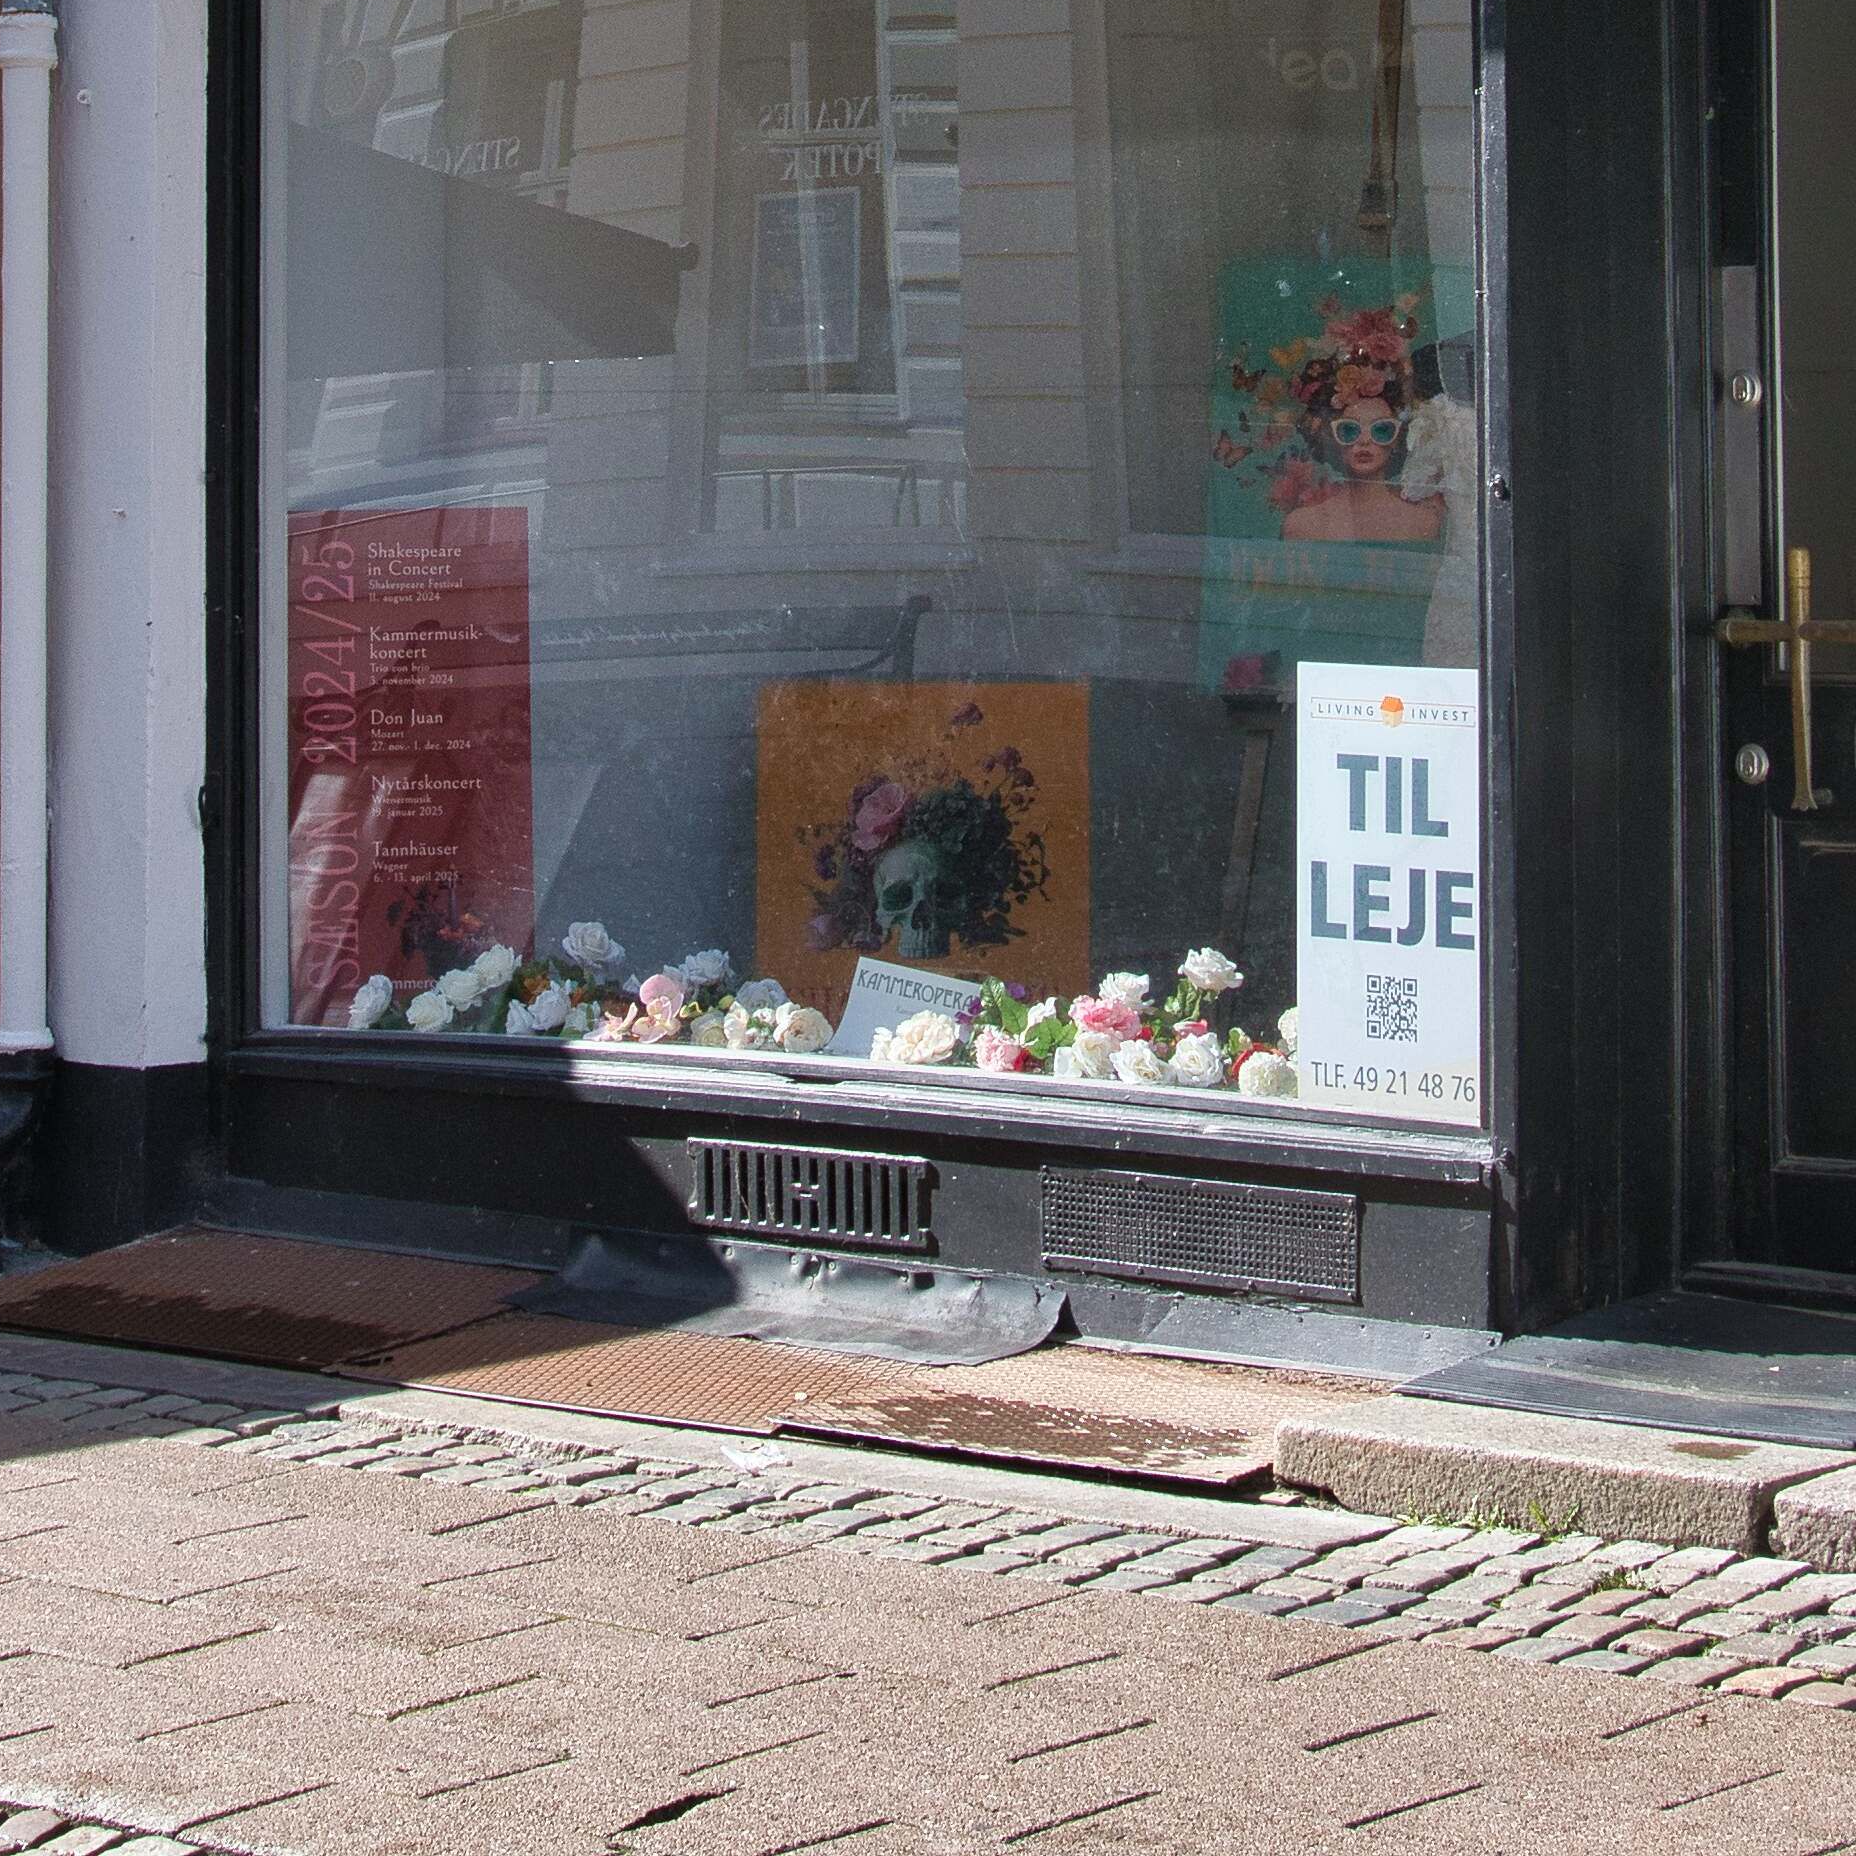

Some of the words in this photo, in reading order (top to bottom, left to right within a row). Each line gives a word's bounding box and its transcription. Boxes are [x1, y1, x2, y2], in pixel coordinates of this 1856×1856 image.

[367, 542, 462, 561] Shakespeare
[367, 562, 382, 576] in
[389, 560, 451, 576] Concert
[416, 591, 442, 602] 2024
[369, 624, 483, 642] Kammermusik-
[301, 540, 361, 764] 2024/25
[369, 643, 427, 660] koncert
[429, 673, 454, 685] 2024
[370, 709, 403, 726] Don
[410, 708, 444, 728] Juan
[1317, 703, 1375, 717] LIVING
[1411, 707, 1469, 722] INVEST
[446, 739, 472, 751] 2024
[371, 774, 483, 795] Nytårskoncert
[1337, 753, 1449, 838] TIL
[419, 805, 444, 817] 2025
[372, 840, 459, 857] Tannhäuser
[1311, 860, 1475, 950] LEJE
[1311, 1061, 1346, 1089] TLF.
[1353, 1066, 1378, 1092] 49
[1386, 1069, 1407, 1095] 21
[1418, 1073, 1443, 1099] 48
[1451, 1075, 1476, 1102] 76
